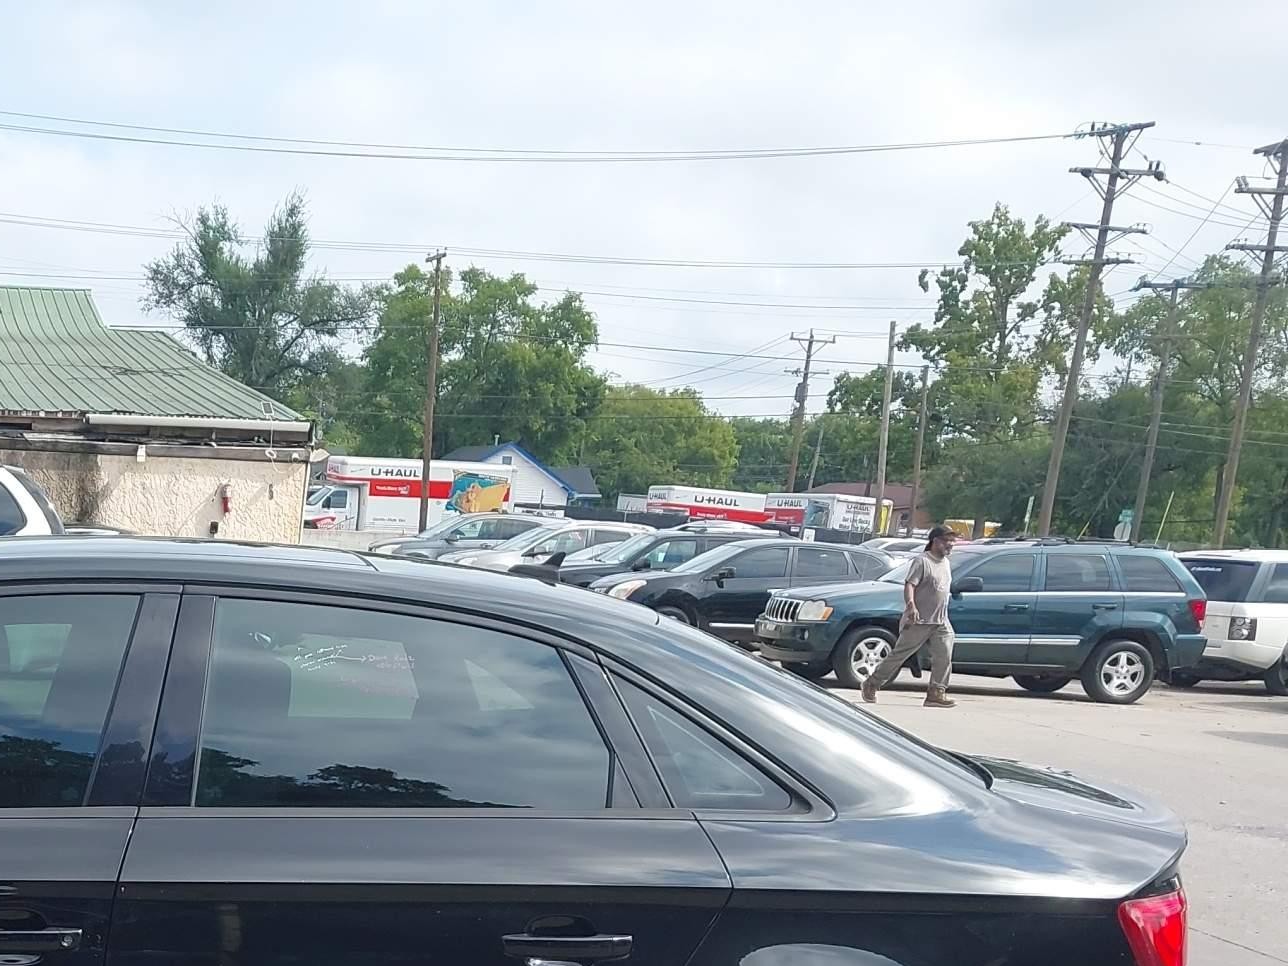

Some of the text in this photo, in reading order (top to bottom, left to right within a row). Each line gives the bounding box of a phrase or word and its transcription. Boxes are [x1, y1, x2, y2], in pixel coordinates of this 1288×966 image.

[370, 467, 420, 478] U-HAUL
[694, 495, 740, 507] U-HAUL
[777, 499, 803, 507] U-HAUL
